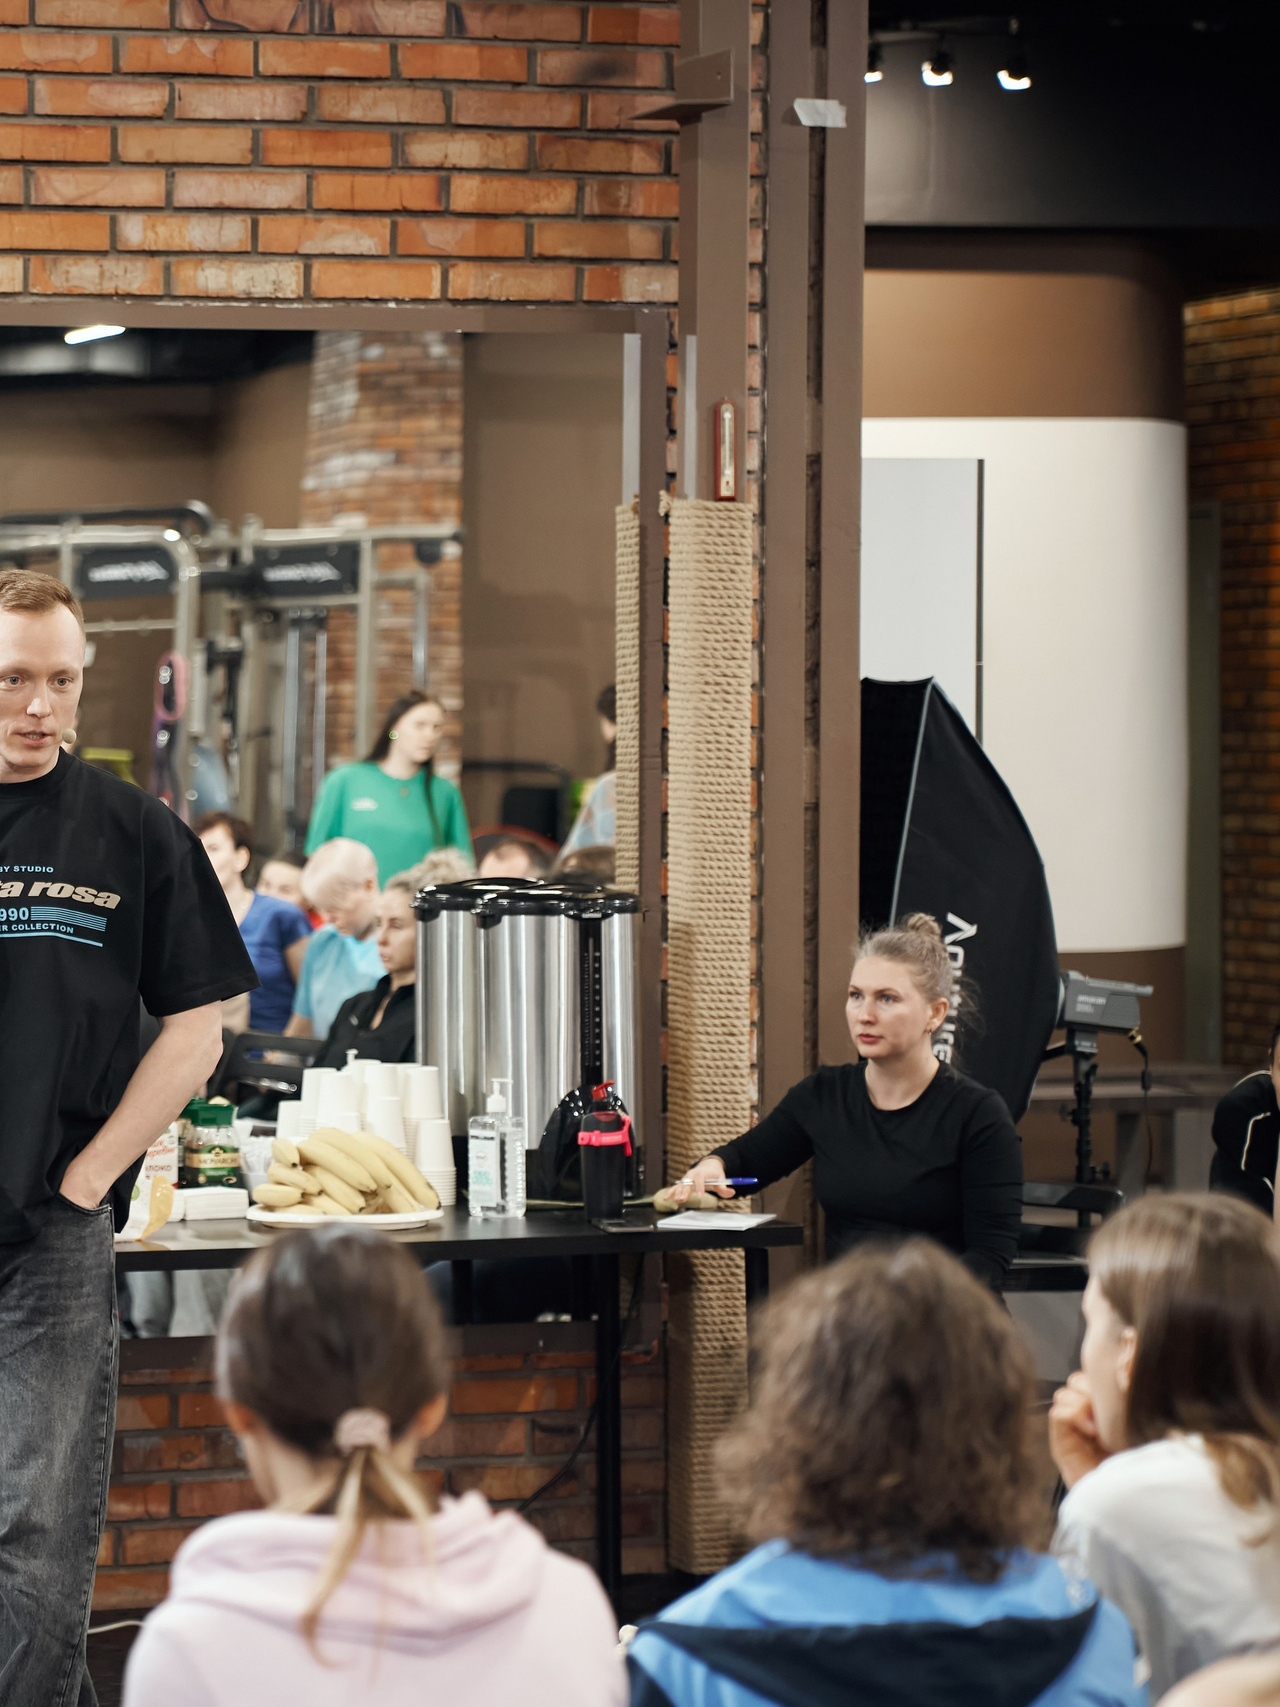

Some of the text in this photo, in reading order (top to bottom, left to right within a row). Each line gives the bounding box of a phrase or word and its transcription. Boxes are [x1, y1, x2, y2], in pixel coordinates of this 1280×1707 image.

[13, 865, 54, 873] STUDIO
[27, 881, 122, 910] rosa
[11, 923, 74, 934] COLLECTION
